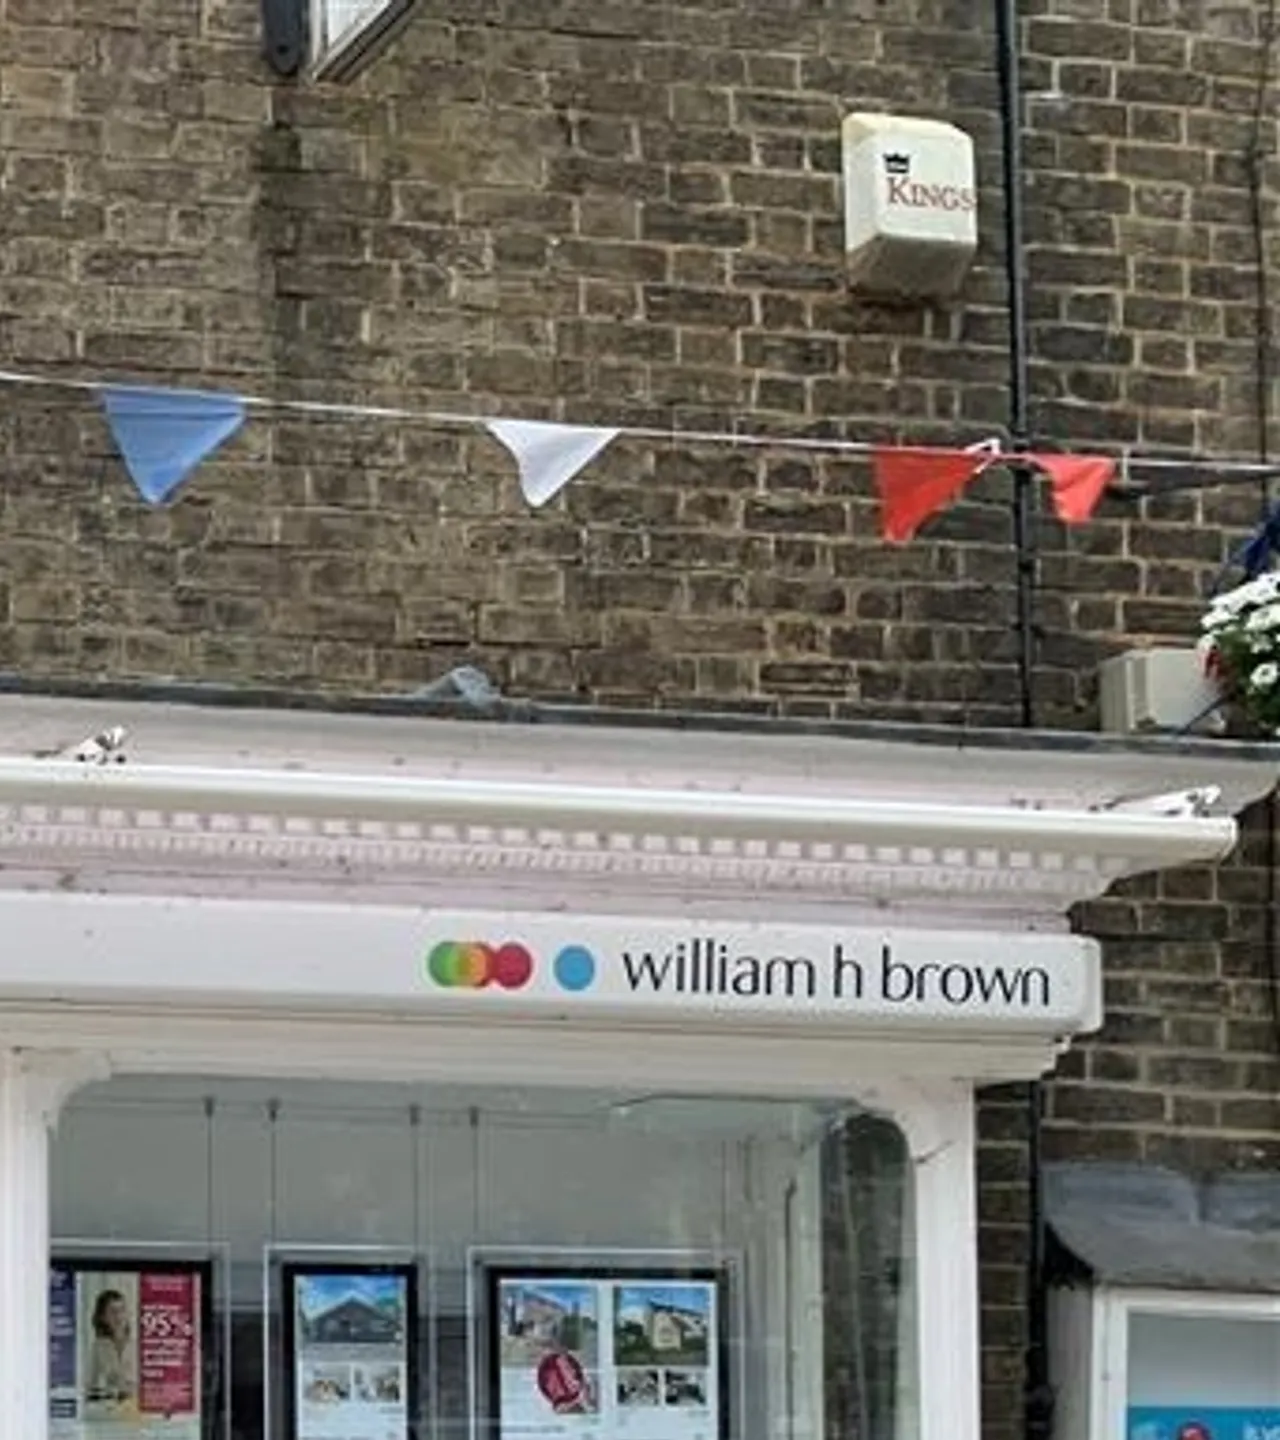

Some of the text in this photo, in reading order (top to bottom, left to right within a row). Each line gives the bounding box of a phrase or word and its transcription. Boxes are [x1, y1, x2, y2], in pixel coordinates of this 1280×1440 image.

[886, 176, 977, 212] KINGS
[622, 938, 1049, 1006] william h brown
